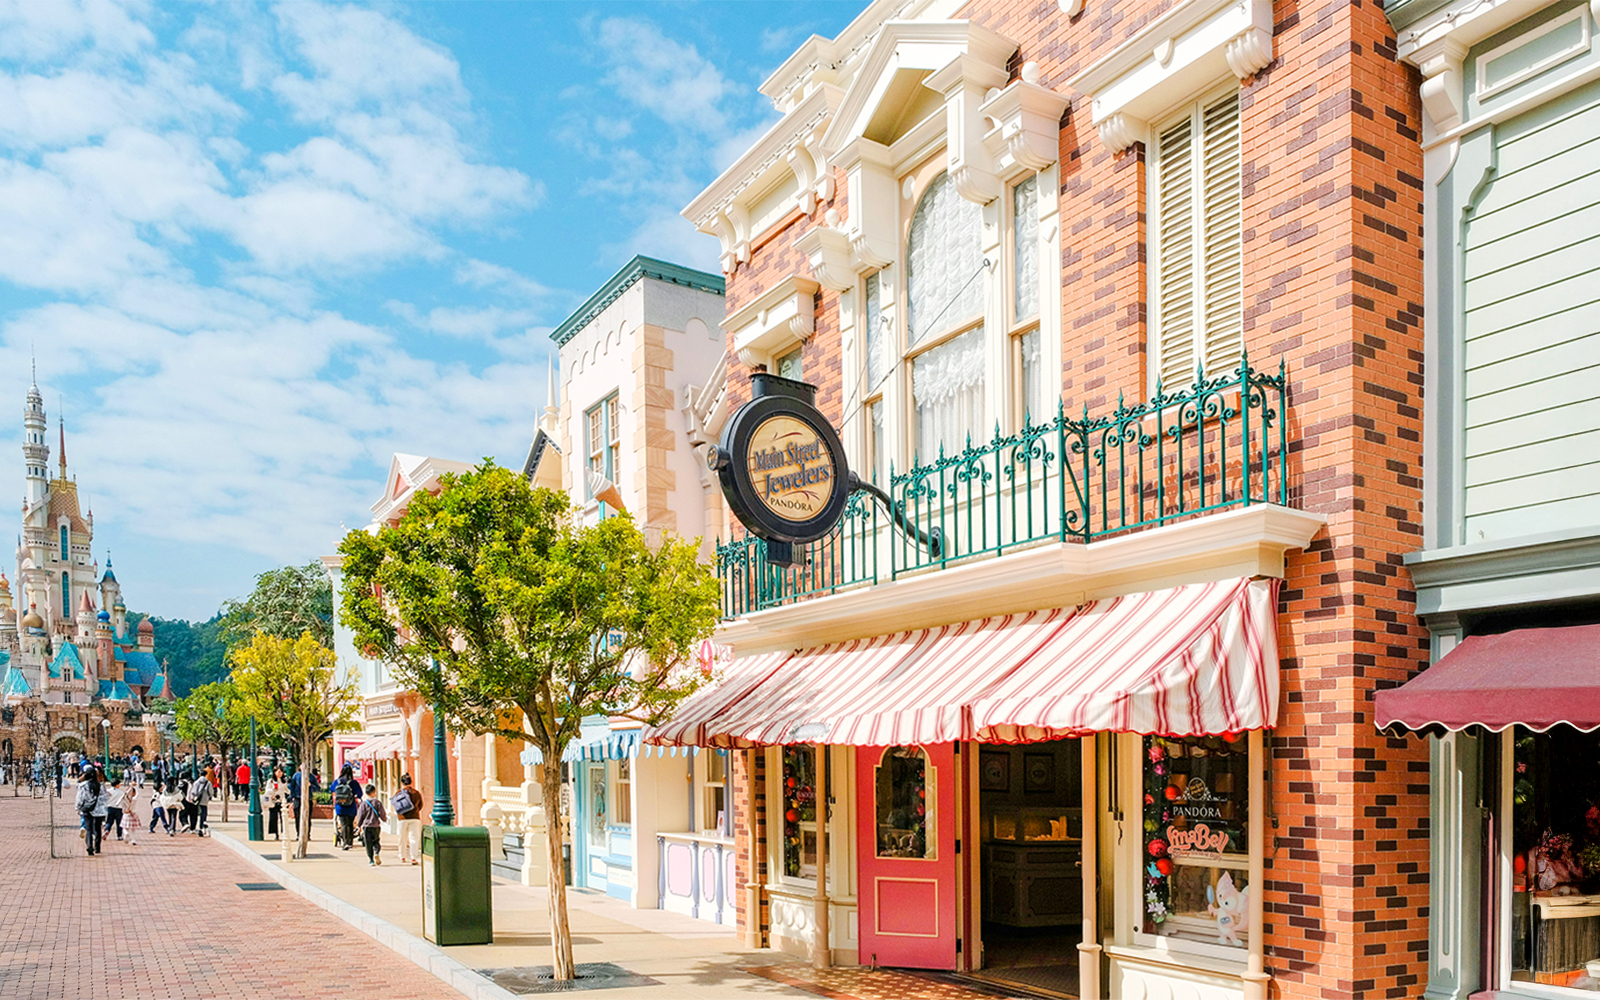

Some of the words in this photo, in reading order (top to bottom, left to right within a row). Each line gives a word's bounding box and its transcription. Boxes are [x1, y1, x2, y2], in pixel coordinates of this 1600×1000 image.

[755, 446, 785, 472] Main
[786, 437, 821, 466] Street
[765, 462, 830, 500] Jewelers
[770, 497, 814, 512] PANDORA
[1172, 804, 1222, 817] PANDORA
